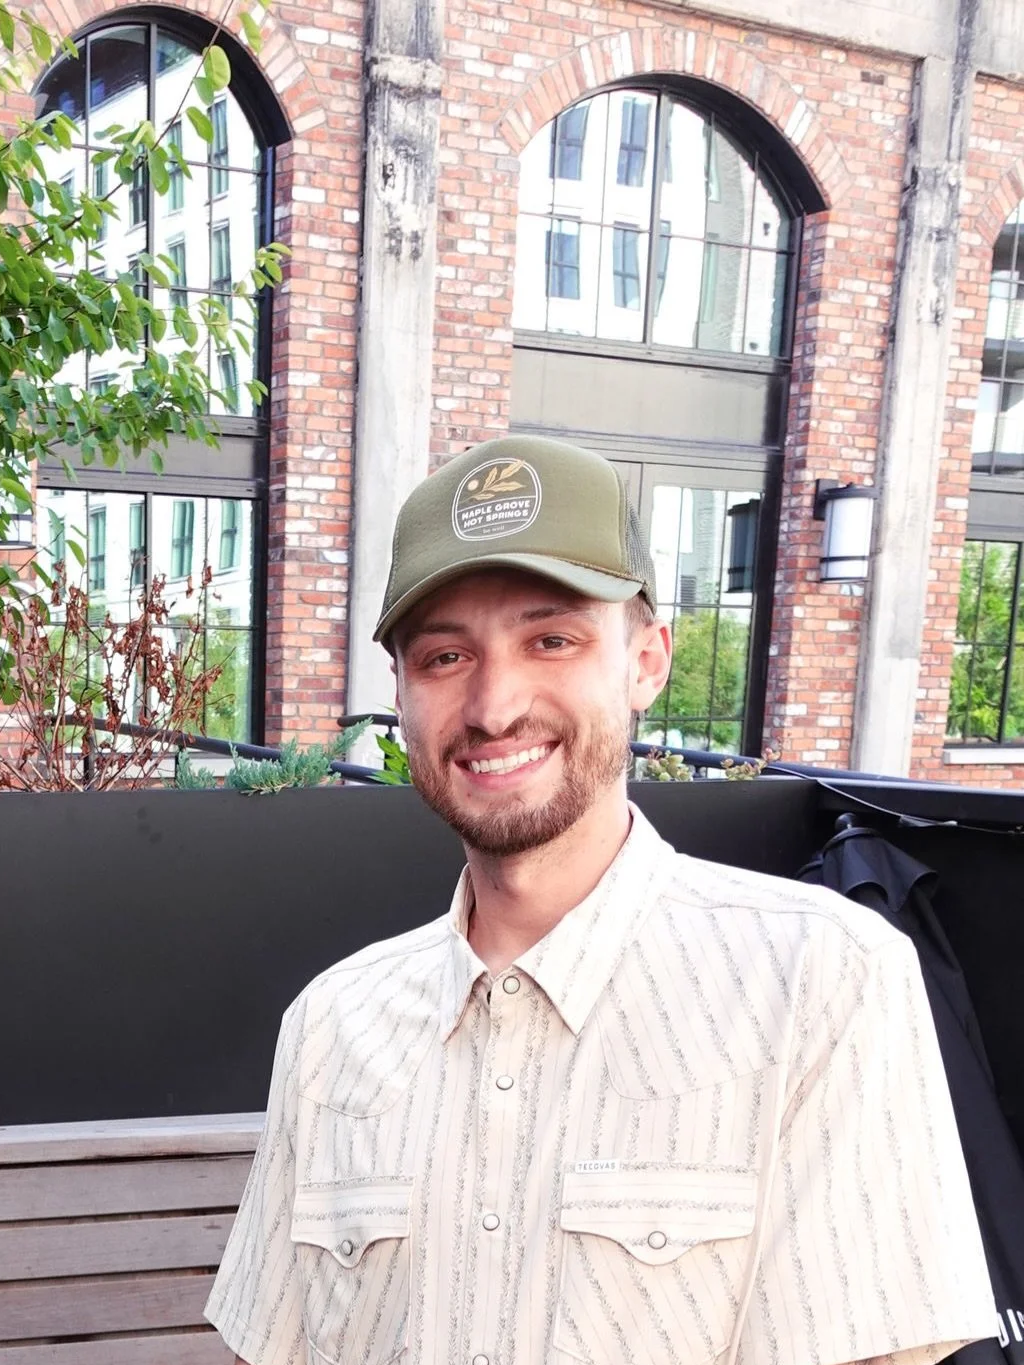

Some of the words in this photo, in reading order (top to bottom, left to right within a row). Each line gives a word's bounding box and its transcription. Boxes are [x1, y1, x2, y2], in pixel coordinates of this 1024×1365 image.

[461, 505, 492, 520] MAPLE
[495, 500, 531, 512] GROVE
[463, 516, 483, 528] HOT
[486, 509, 529, 522] SPRINGS
[578, 1162, 616, 1171] TECOVAS
